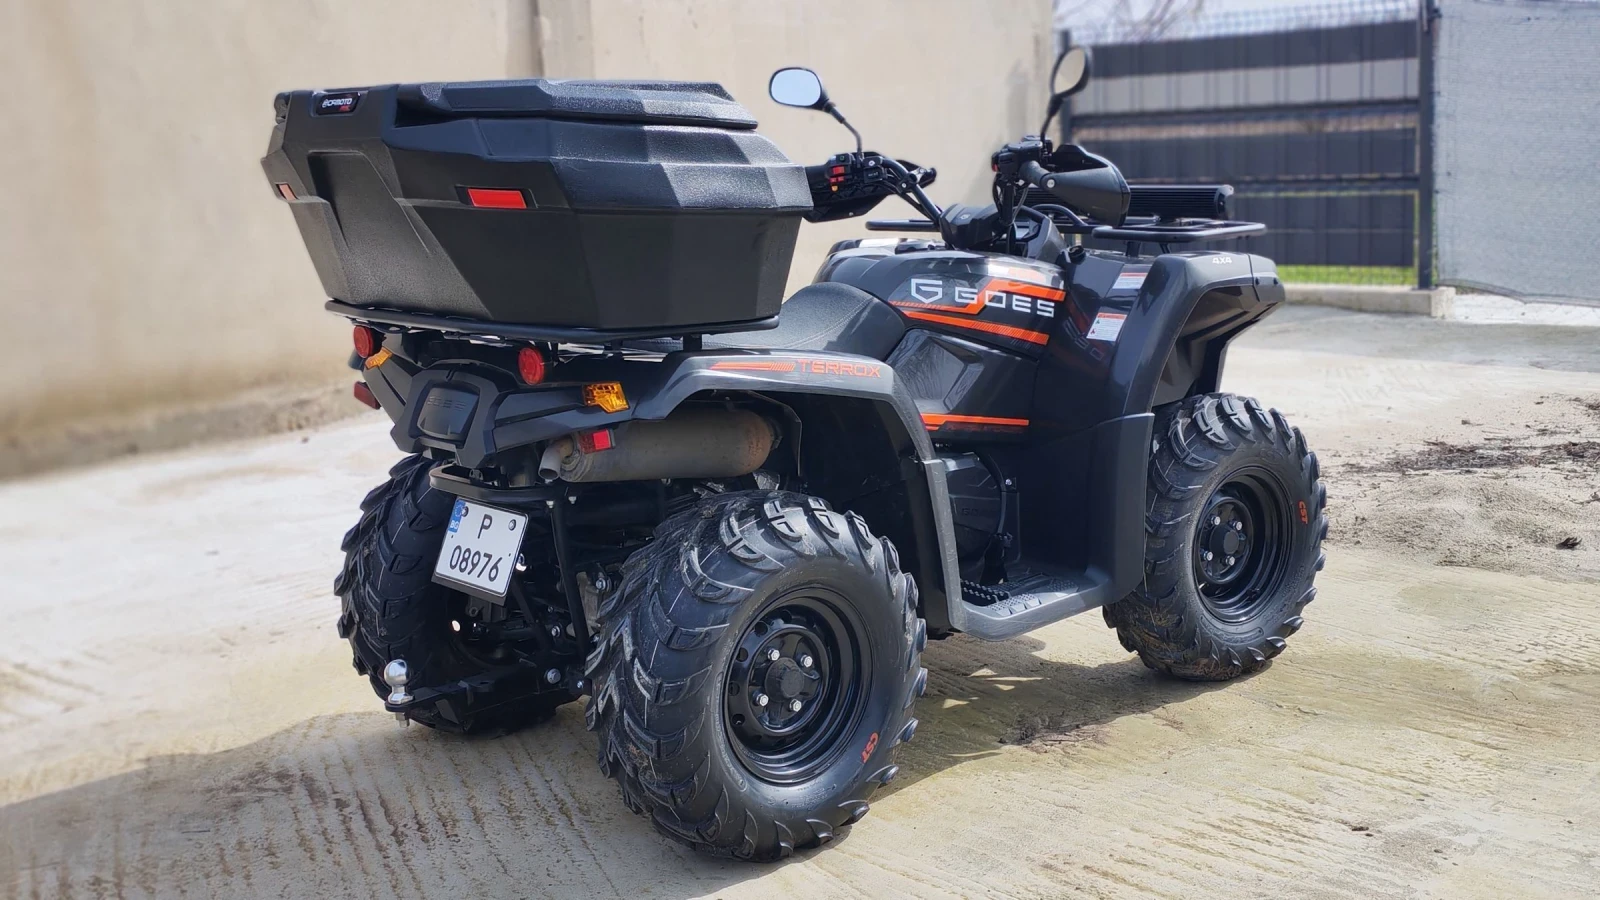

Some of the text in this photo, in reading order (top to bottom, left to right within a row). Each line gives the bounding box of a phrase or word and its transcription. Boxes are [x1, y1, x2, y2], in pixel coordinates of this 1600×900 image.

[954, 286, 1055, 318] GOES
[797, 359, 881, 378] TERROX
[477, 513, 493, 539] P
[1299, 500, 1308, 525] CST
[449, 545, 503, 582] 08976
[861, 732, 879, 764] CST
